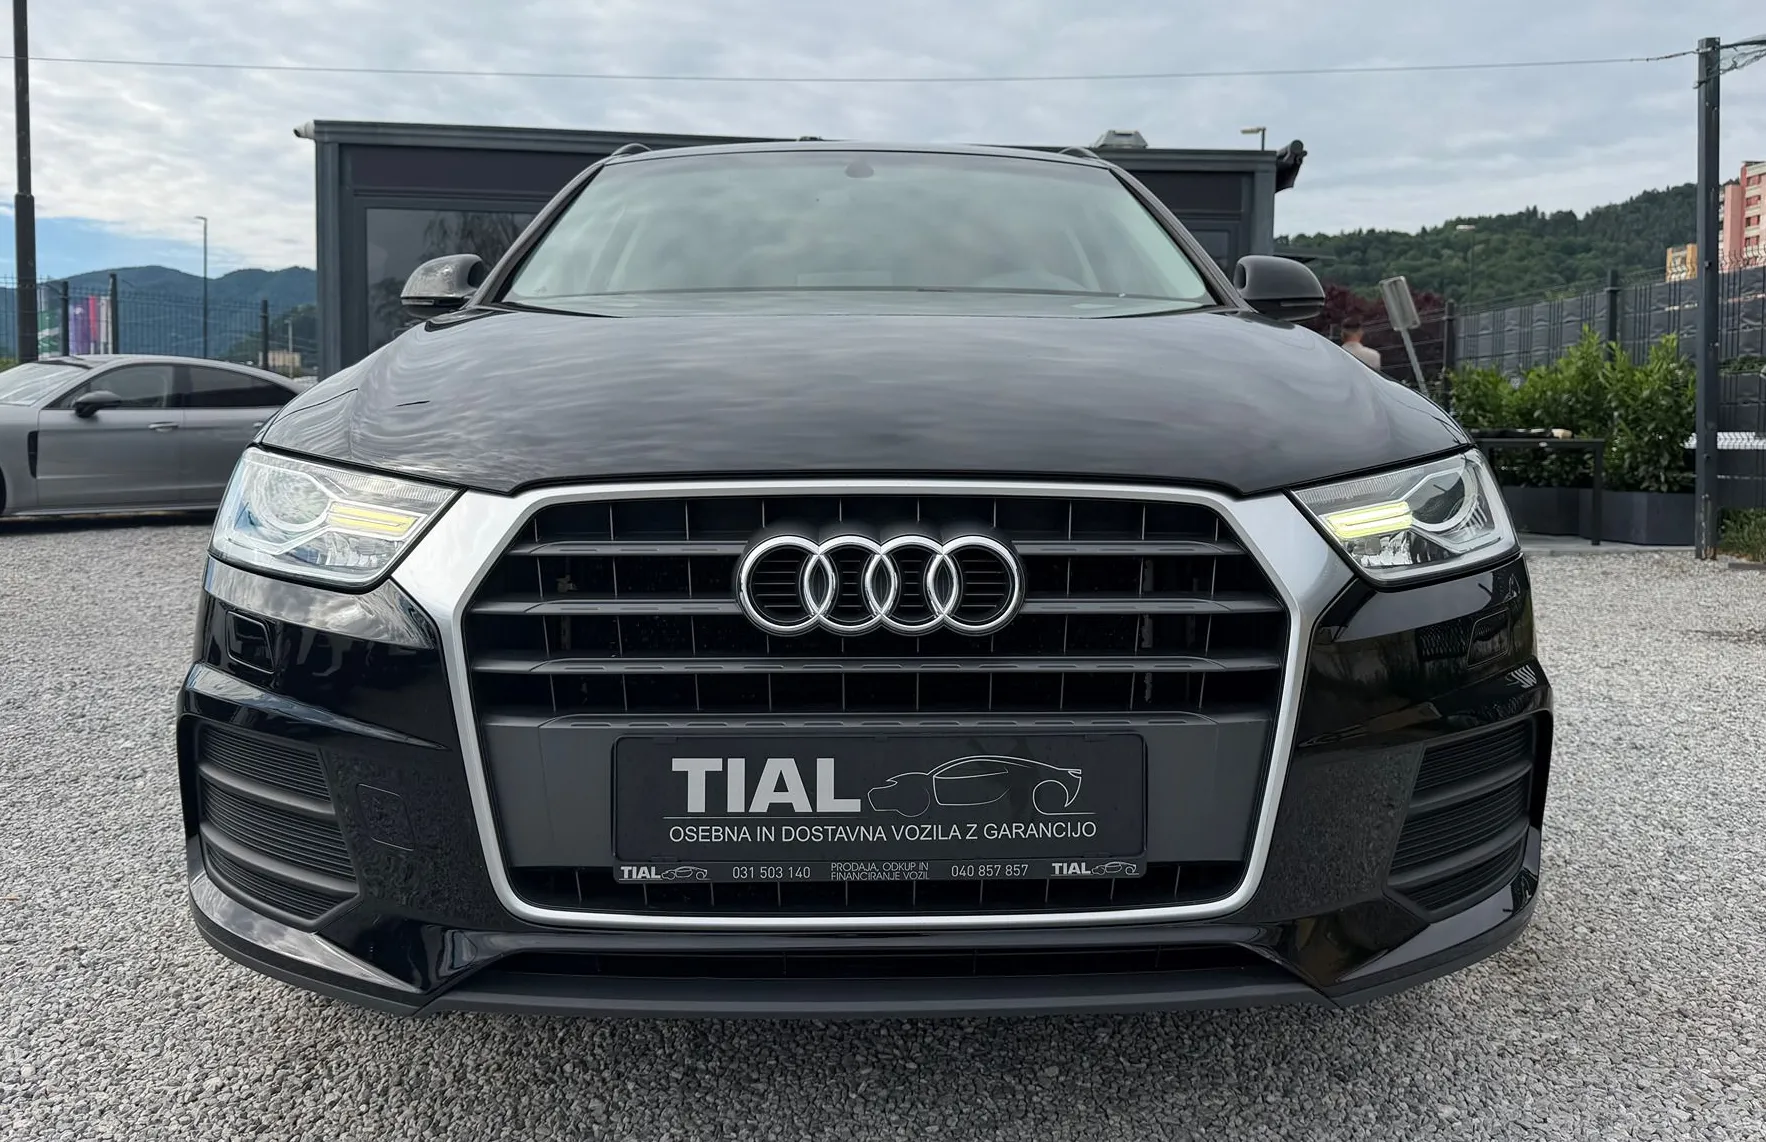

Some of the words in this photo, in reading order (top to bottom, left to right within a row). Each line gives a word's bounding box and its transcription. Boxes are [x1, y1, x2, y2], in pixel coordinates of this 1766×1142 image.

[672, 758, 861, 813] TIAL
[669, 826, 752, 842] OSEBNA
[757, 826, 775, 841] IN
[782, 825, 887, 842] DOSTAVNA
[891, 824, 962, 841] VOZILA
[966, 824, 979, 840] Z
[983, 822, 1097, 839] GARANCIJO
[620, 866, 661, 879] TIAL
[732, 866, 754, 879] 031
[760, 866, 783, 879] 503
[788, 866, 811, 879] 140
[831, 862, 880, 872] PRODAJA,
[882, 862, 917, 872] ODKUP
[918, 861, 929, 871] IN
[951, 865, 975, 877] 040
[978, 865, 1001, 877] 857
[1005, 864, 1029, 877] 857
[1051, 862, 1091, 875] TIAL
[831, 871, 901, 881] FINANCIRANJE
[903, 871, 930, 880] VOZIL
